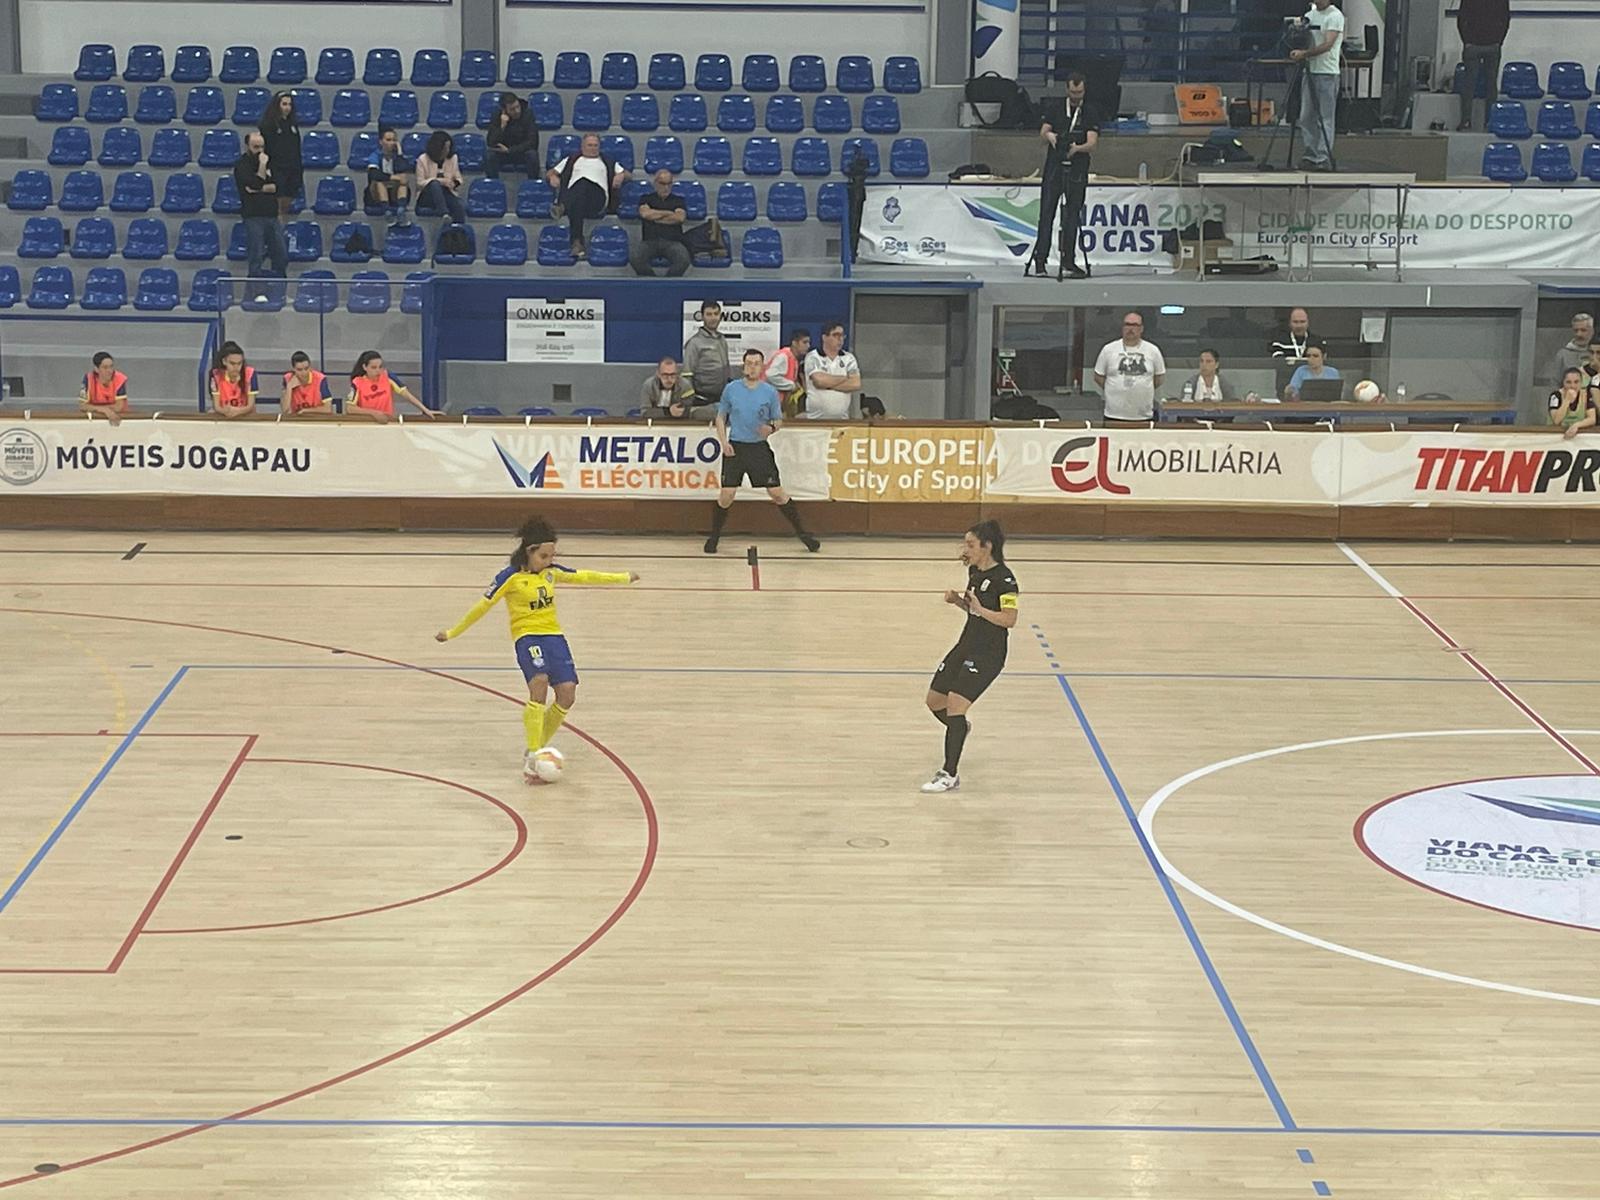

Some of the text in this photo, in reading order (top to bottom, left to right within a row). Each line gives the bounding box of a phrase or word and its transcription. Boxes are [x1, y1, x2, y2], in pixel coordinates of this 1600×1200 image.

[1080, 204, 1149, 227] IANA
[1258, 213, 1573, 230] CIDADE EUROPEIA DO DESPORTO
[1103, 230, 1173, 252] CAST
[1257, 231, 1417, 248] European City of Sport
[516, 307, 595, 320] ONWORKS
[693, 310, 771, 322] OWORKS
[56, 438, 311, 472] MÓVEIS JOGAPAU
[579, 436, 721, 464] METALO
[851, 438, 1001, 465] EUROPEIA
[1117, 444, 1283, 474] IMOBILIÁRIA
[580, 465, 720, 489] ELÉCTRICA
[843, 468, 889, 494] City
[898, 468, 924, 489] of
[931, 469, 994, 495] Sport
[1415, 447, 1600, 493] TITANPR
[1427, 846, 1479, 858] DO
[1429, 838, 1551, 855] VIANA
